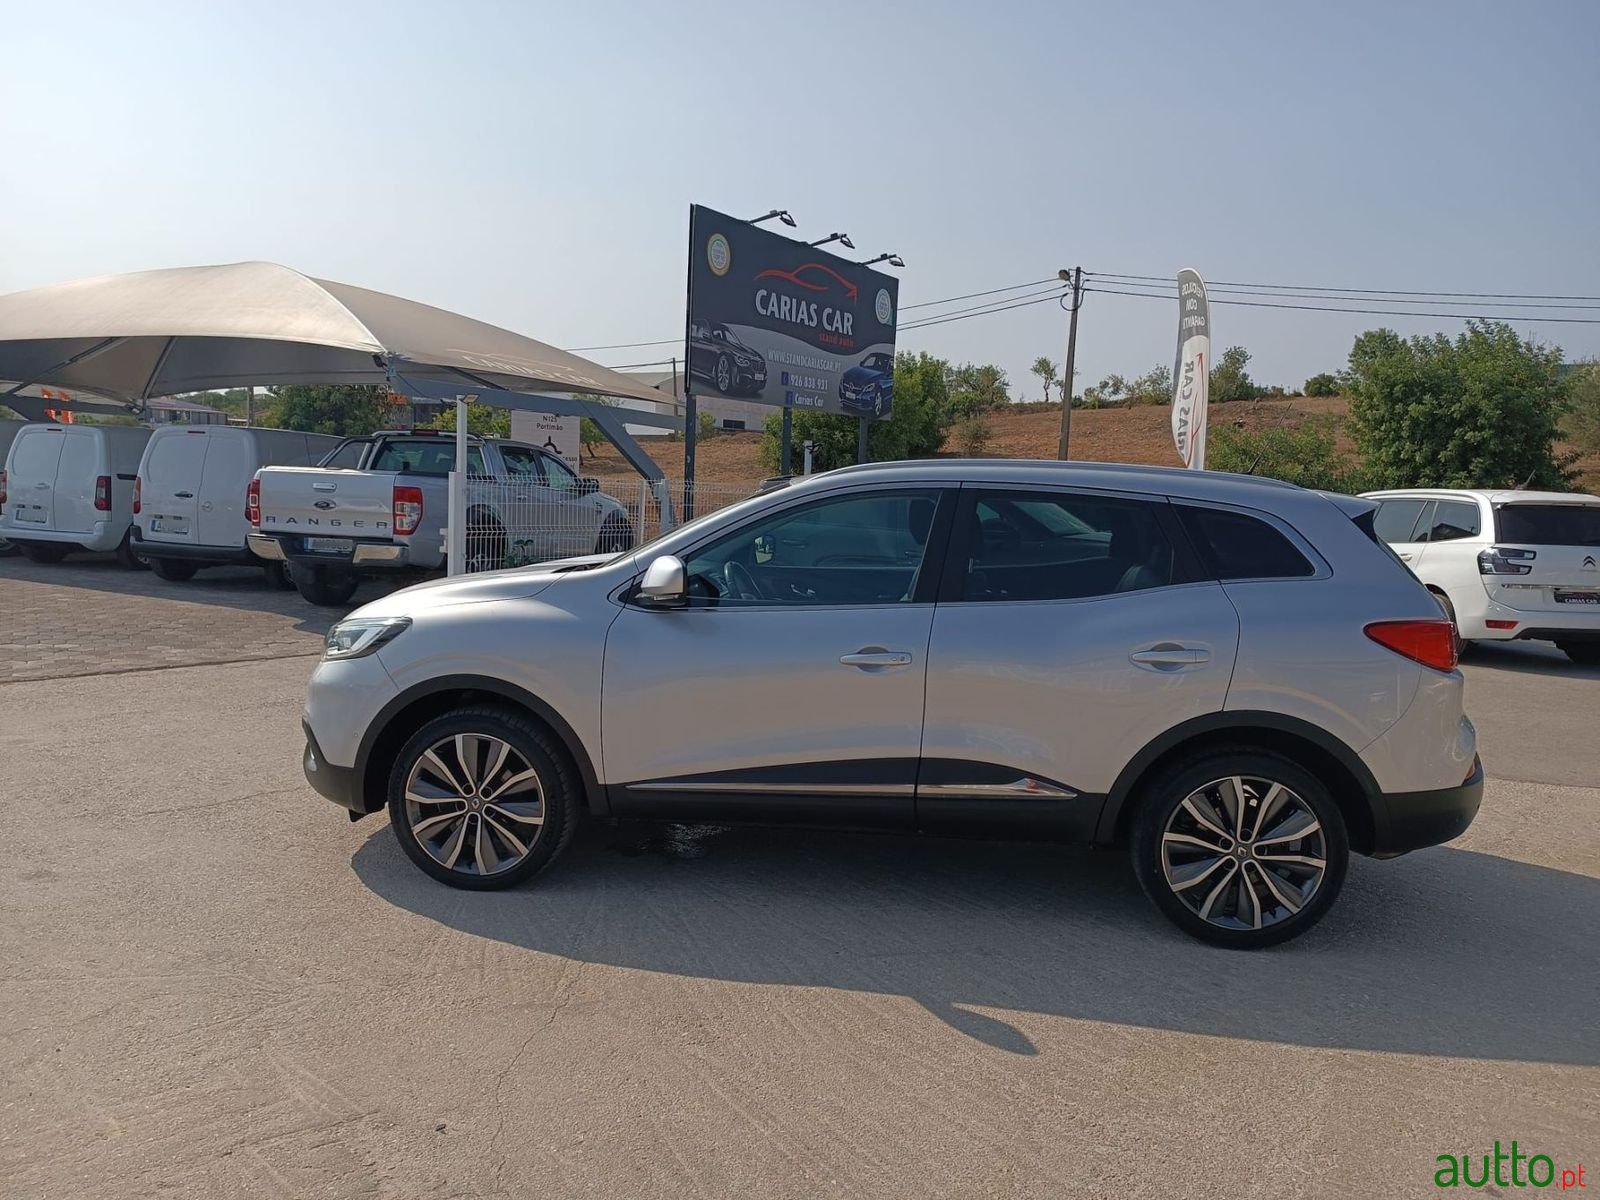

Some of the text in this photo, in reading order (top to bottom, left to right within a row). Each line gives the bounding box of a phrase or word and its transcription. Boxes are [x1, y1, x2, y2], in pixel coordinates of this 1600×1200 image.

[756, 289, 853, 336] CARIAS CAR
[814, 395, 824, 407] Car
[265, 515, 388, 528] RANGER
